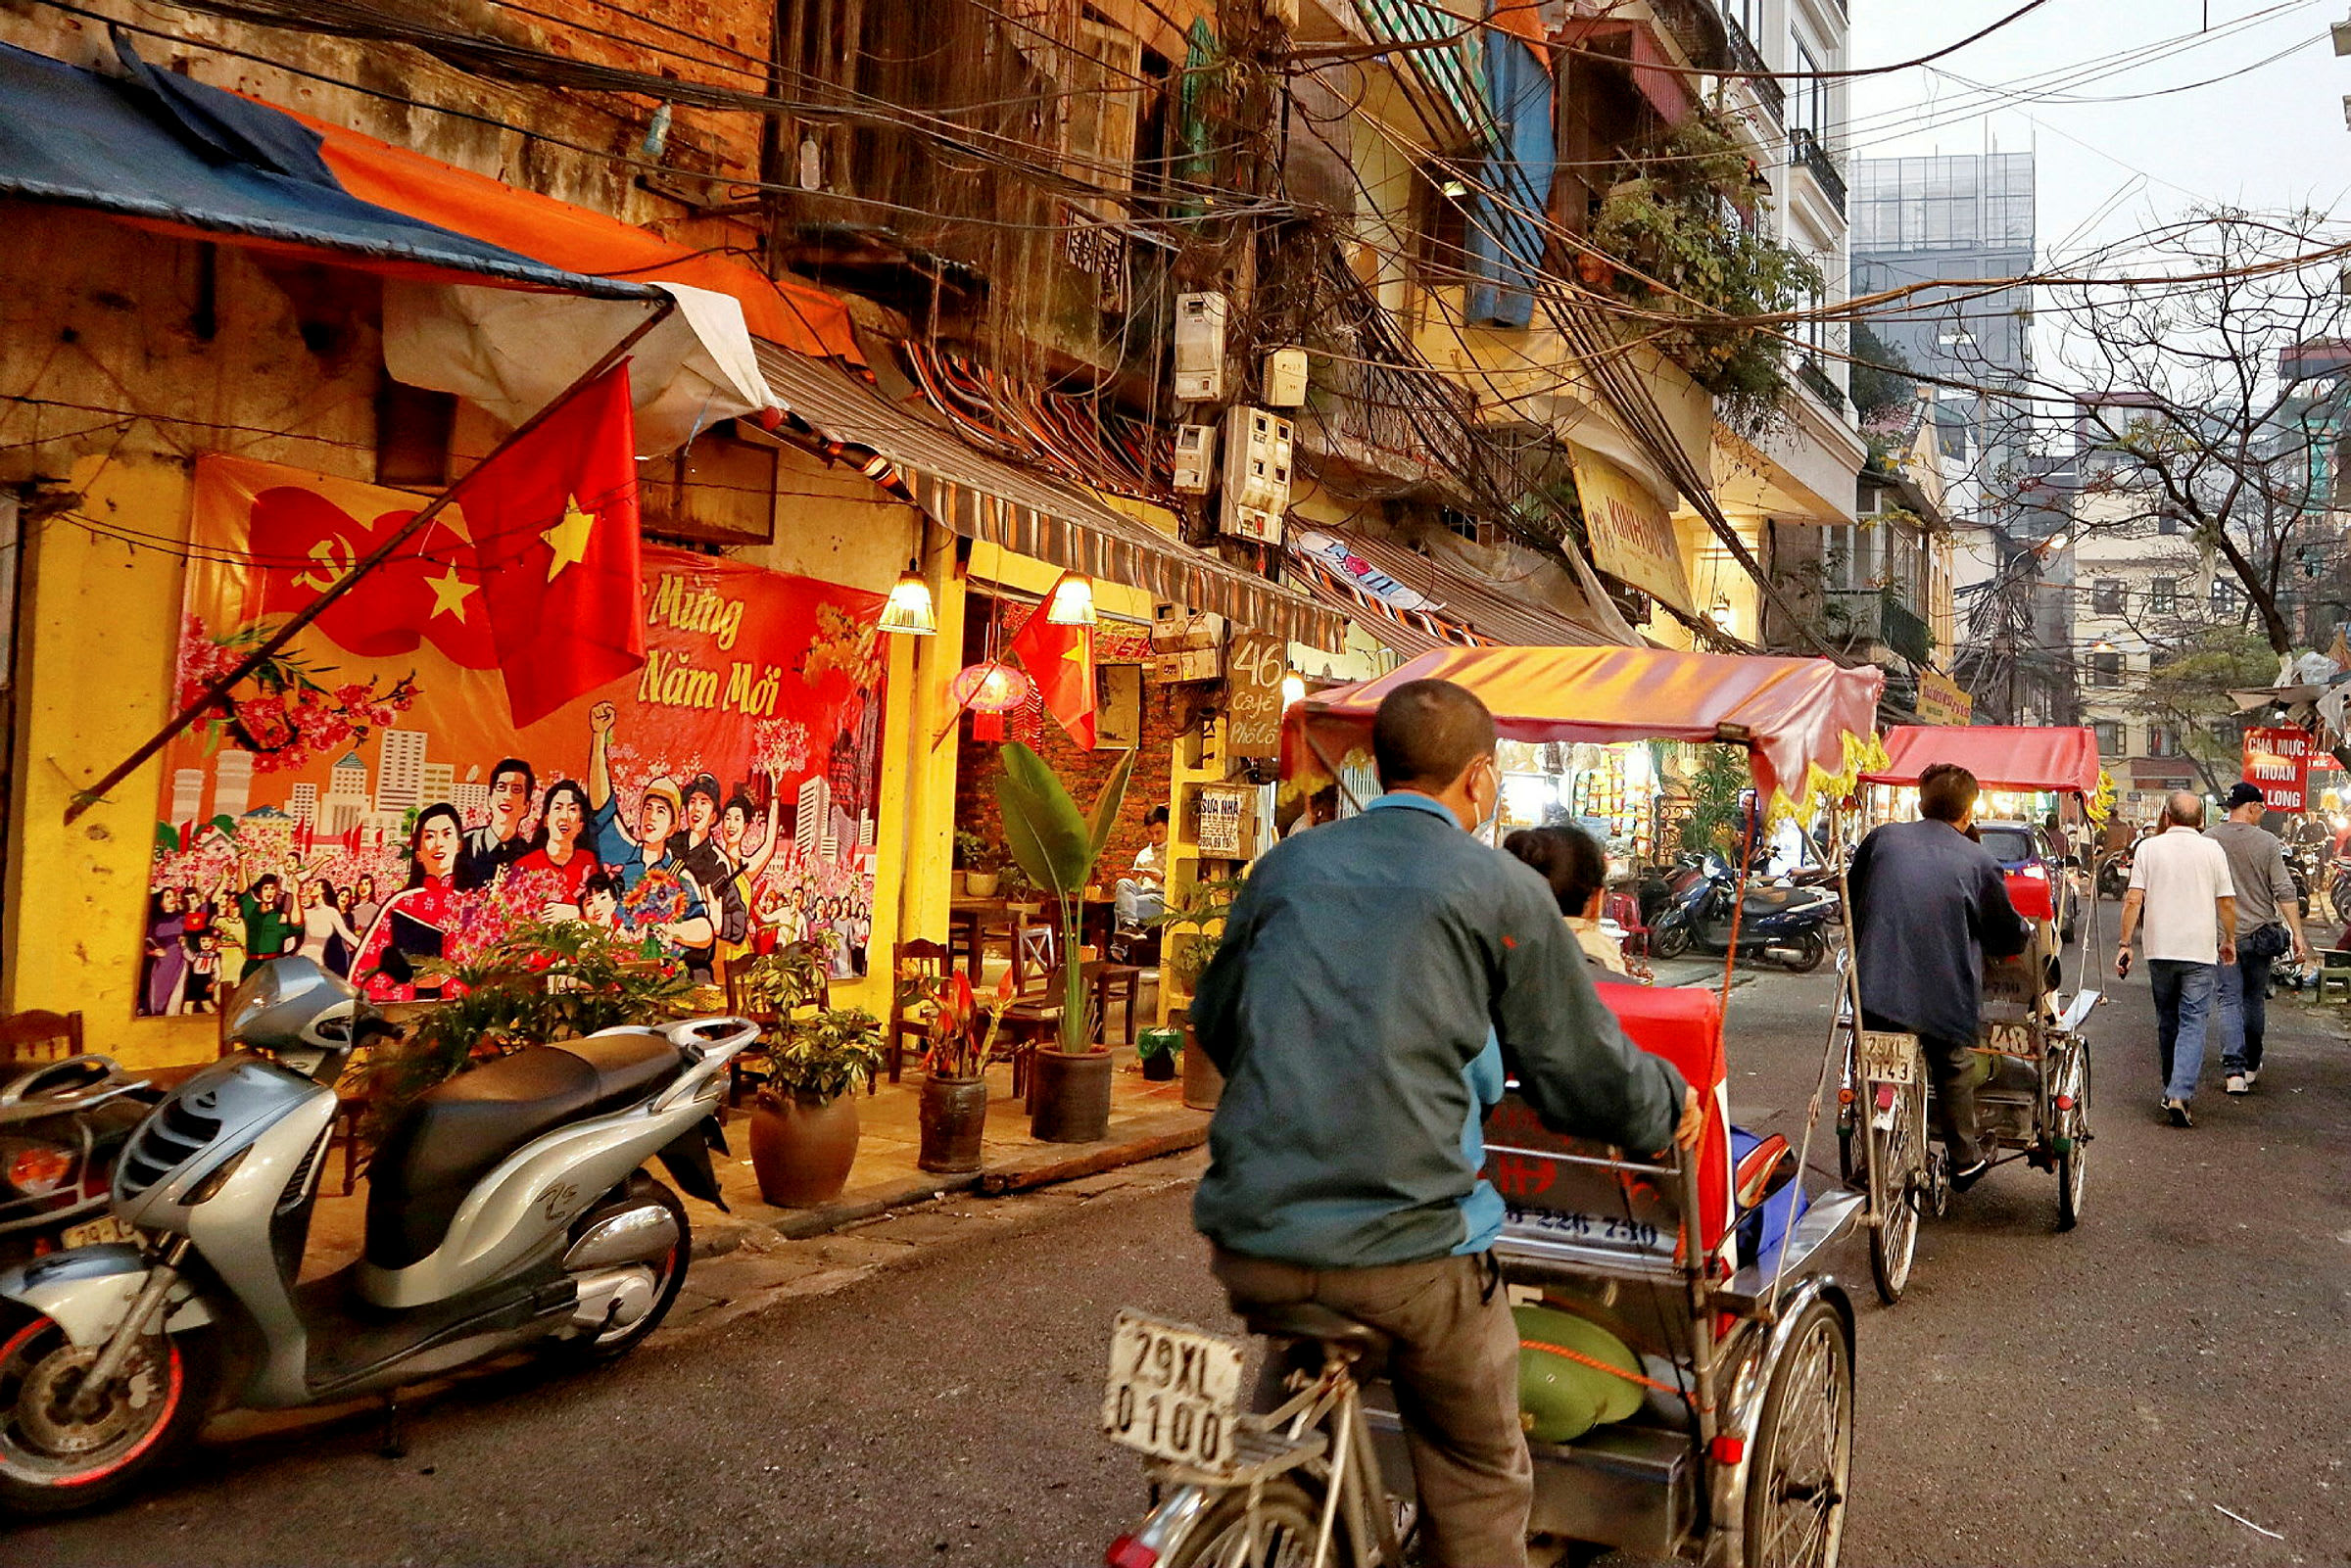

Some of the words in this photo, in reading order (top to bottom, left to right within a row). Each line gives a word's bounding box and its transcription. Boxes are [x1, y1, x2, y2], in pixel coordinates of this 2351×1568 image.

[648, 573, 744, 650] Mừng
[638, 649, 719, 709] Năm
[721, 662, 782, 716] Mới
[1233, 640, 1282, 688] 46
[1232, 688, 1278, 720] Café
[2247, 732, 2274, 755] CHẢ
[2277, 738, 2306, 760] MỰC
[2254, 764, 2297, 782] THOAN
[2267, 789, 2301, 807] LONG
[1131, 1332, 1213, 1401] 29XL
[1117, 1384, 1221, 1462] 0100
